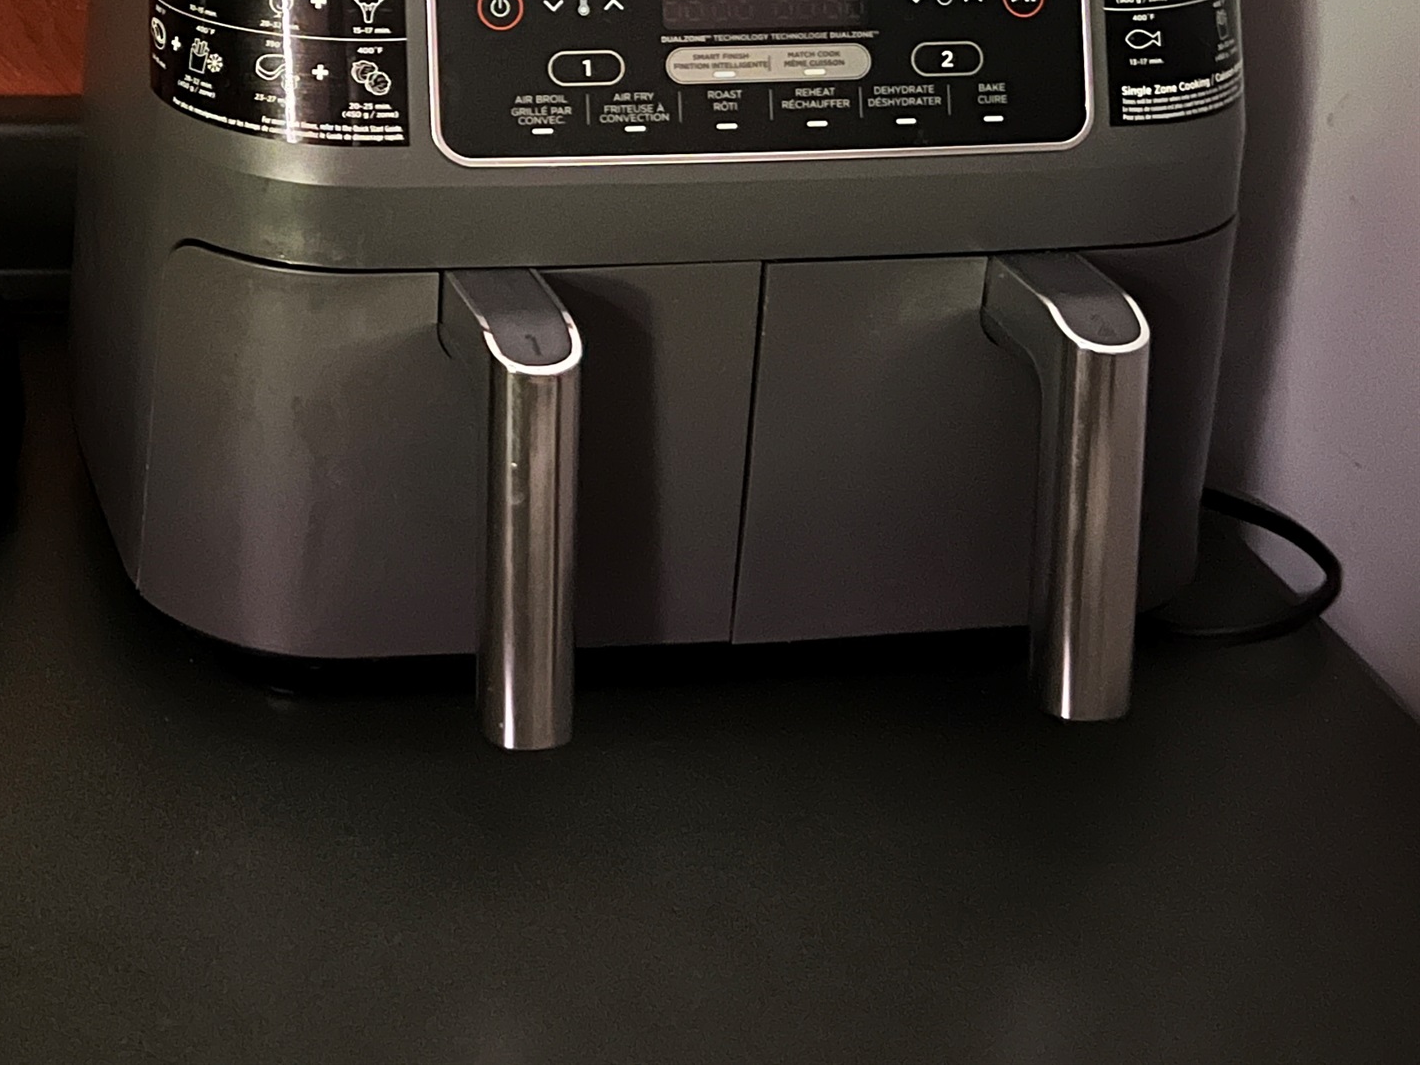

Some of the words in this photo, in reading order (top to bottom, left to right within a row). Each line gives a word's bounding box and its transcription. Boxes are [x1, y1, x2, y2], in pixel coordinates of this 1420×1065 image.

[713, 34, 769, 42] TECHNOLOGY
[771, 32, 828, 40] TECHNOLOGIE
[693, 53, 720, 61] SMART
[940, 50, 954, 69] 2
[674, 62, 709, 70] FINITION
[809, 59, 845, 67] CUISSON
[582, 59, 593, 78] 1
[795, 87, 835, 97] REHEAT
[873, 85, 935, 95] DEHYDRATE
[978, 83, 1006, 92] BAKE
[1121, 85, 1152, 98] Single
[1154, 84, 1177, 95] Zone
[1179, 78, 1210, 91] Cooking
[515, 95, 533, 104] AIR
[536, 95, 568, 103] BROIL
[613, 93, 631, 102] AIR
[633, 92, 654, 101] FRY
[707, 90, 742, 99] ROAST
[978, 95, 1007, 104] CUIRE
[713, 101, 738, 112] RÔTI
[781, 99, 850, 109] RÉCHAUFFER
[867, 97, 942, 107] DÉSHYDRATER
[511, 106, 548, 116] GRILLÉ
[551, 106, 572, 115] PAR
[603, 104, 653, 114] FRITEUSE
[656, 102, 665, 112] À
[599, 113, 670, 123] CONVECTION
